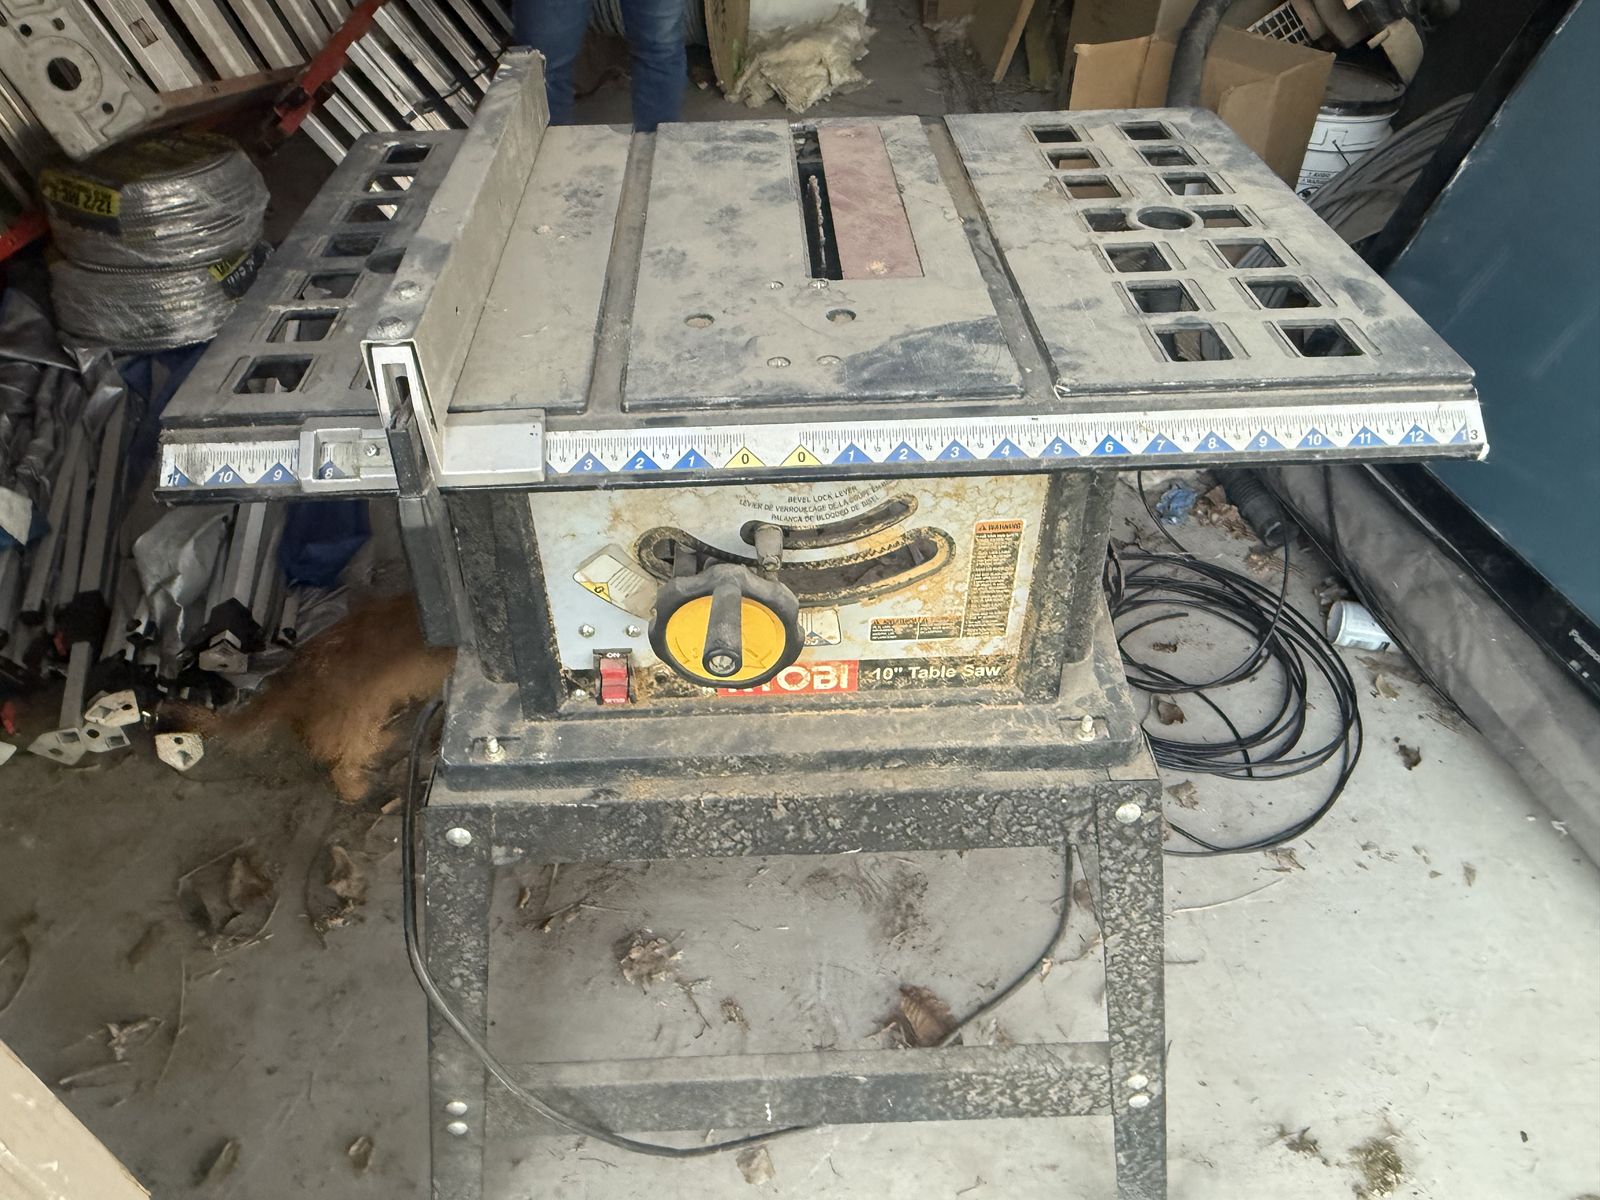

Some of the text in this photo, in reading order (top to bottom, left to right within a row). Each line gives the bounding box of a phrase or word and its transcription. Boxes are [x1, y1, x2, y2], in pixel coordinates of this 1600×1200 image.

[584, 459, 593, 470] 3
[634, 457, 645, 469] 2
[688, 456, 695, 467] 1
[741, 453, 750, 464] 0
[798, 451, 806, 462] 0
[848, 451, 855, 462] 1
[899, 449, 908, 460] 2
[950, 447, 960, 458] 3
[1001, 445, 1010, 457] 4
[1054, 443, 1062, 455] 5
[1105, 441, 1114, 453] 6
[1157, 440, 1166, 451] 7
[1208, 438, 1217, 449] 8
[1259, 436, 1268, 447] 9
[1307, 434, 1322, 446] 10
[1358, 432, 1372, 444] 11
[1409, 430, 1425, 442] 12
[1461, 429, 1478, 441] 13
[168, 468, 333, 485] 11 10 9 8
[787, 485, 857, 503] BEVEL LOCK LEVER
[606, 652, 621, 660] ON
[728, 664, 849, 693] OBI
[872, 664, 1002, 681] 10" Table Saw
